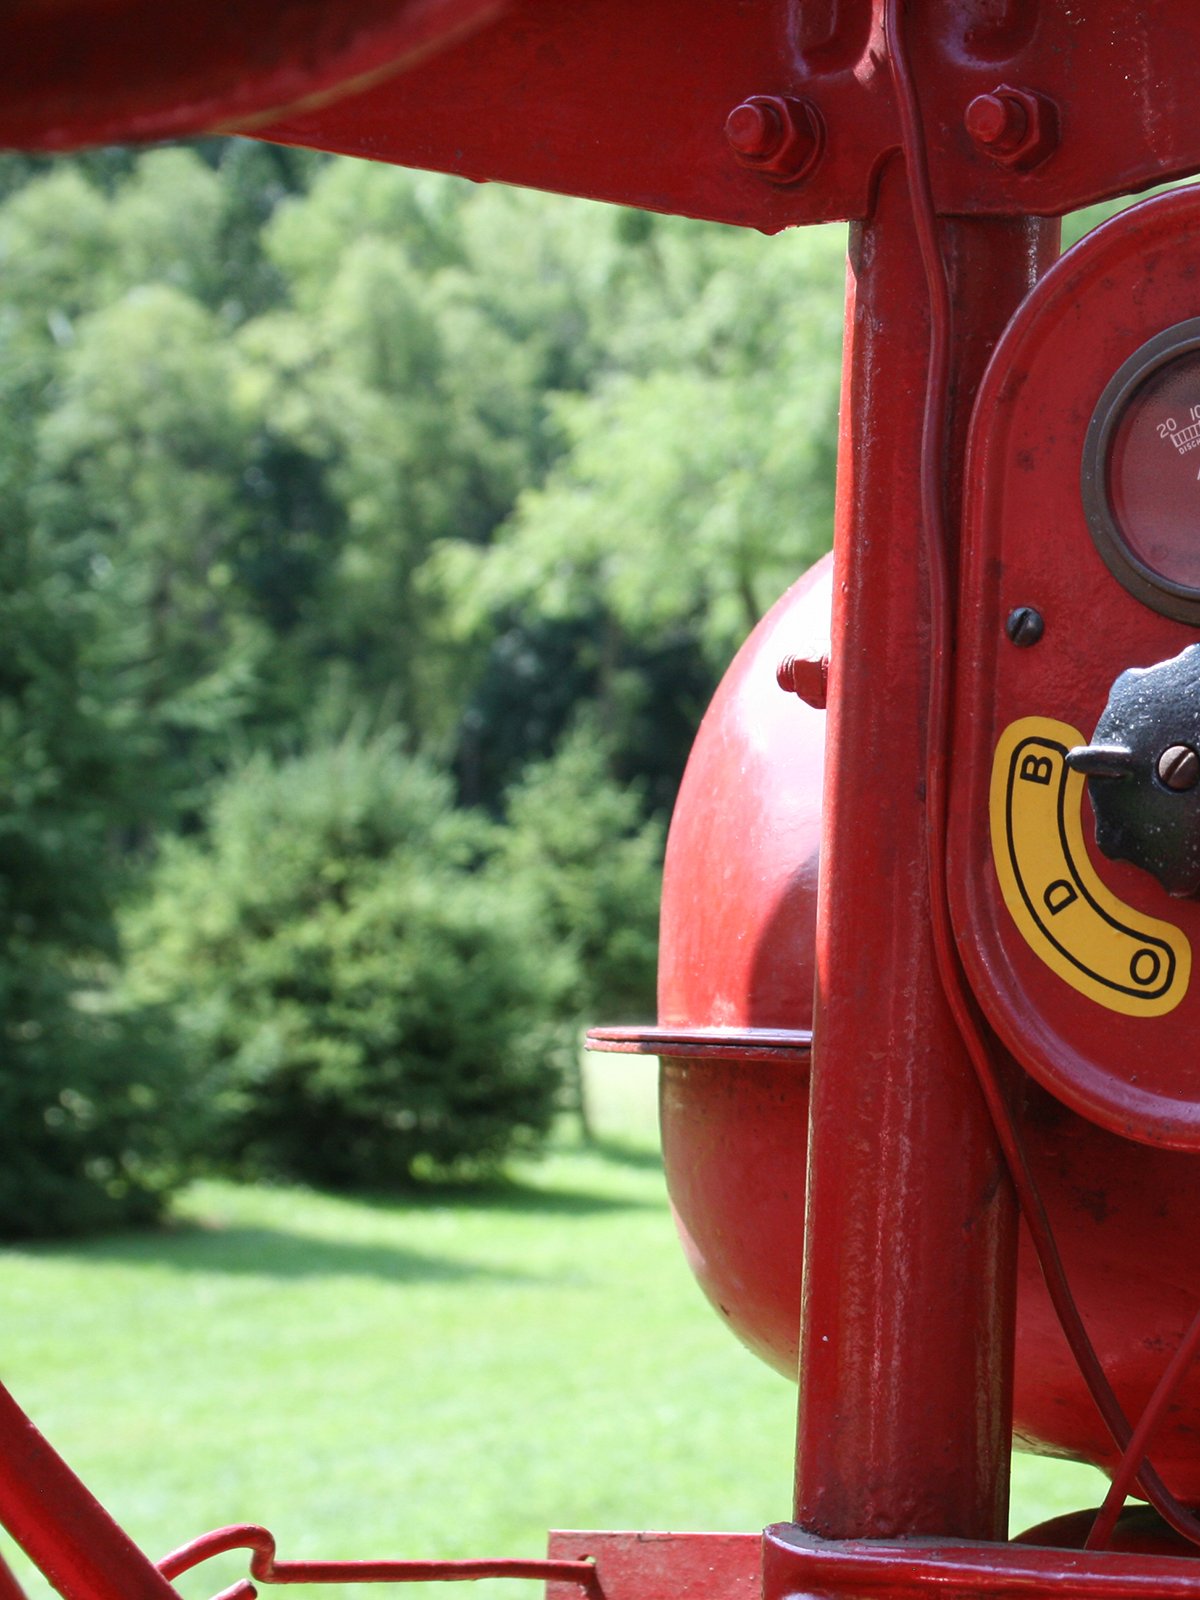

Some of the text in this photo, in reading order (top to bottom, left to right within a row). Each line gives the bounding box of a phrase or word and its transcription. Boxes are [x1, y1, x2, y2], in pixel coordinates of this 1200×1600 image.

[1157, 417, 1178, 439] 20
[1020, 754, 1053, 785] B
[1043, 879, 1079, 915] D
[1129, 948, 1161, 985] O
